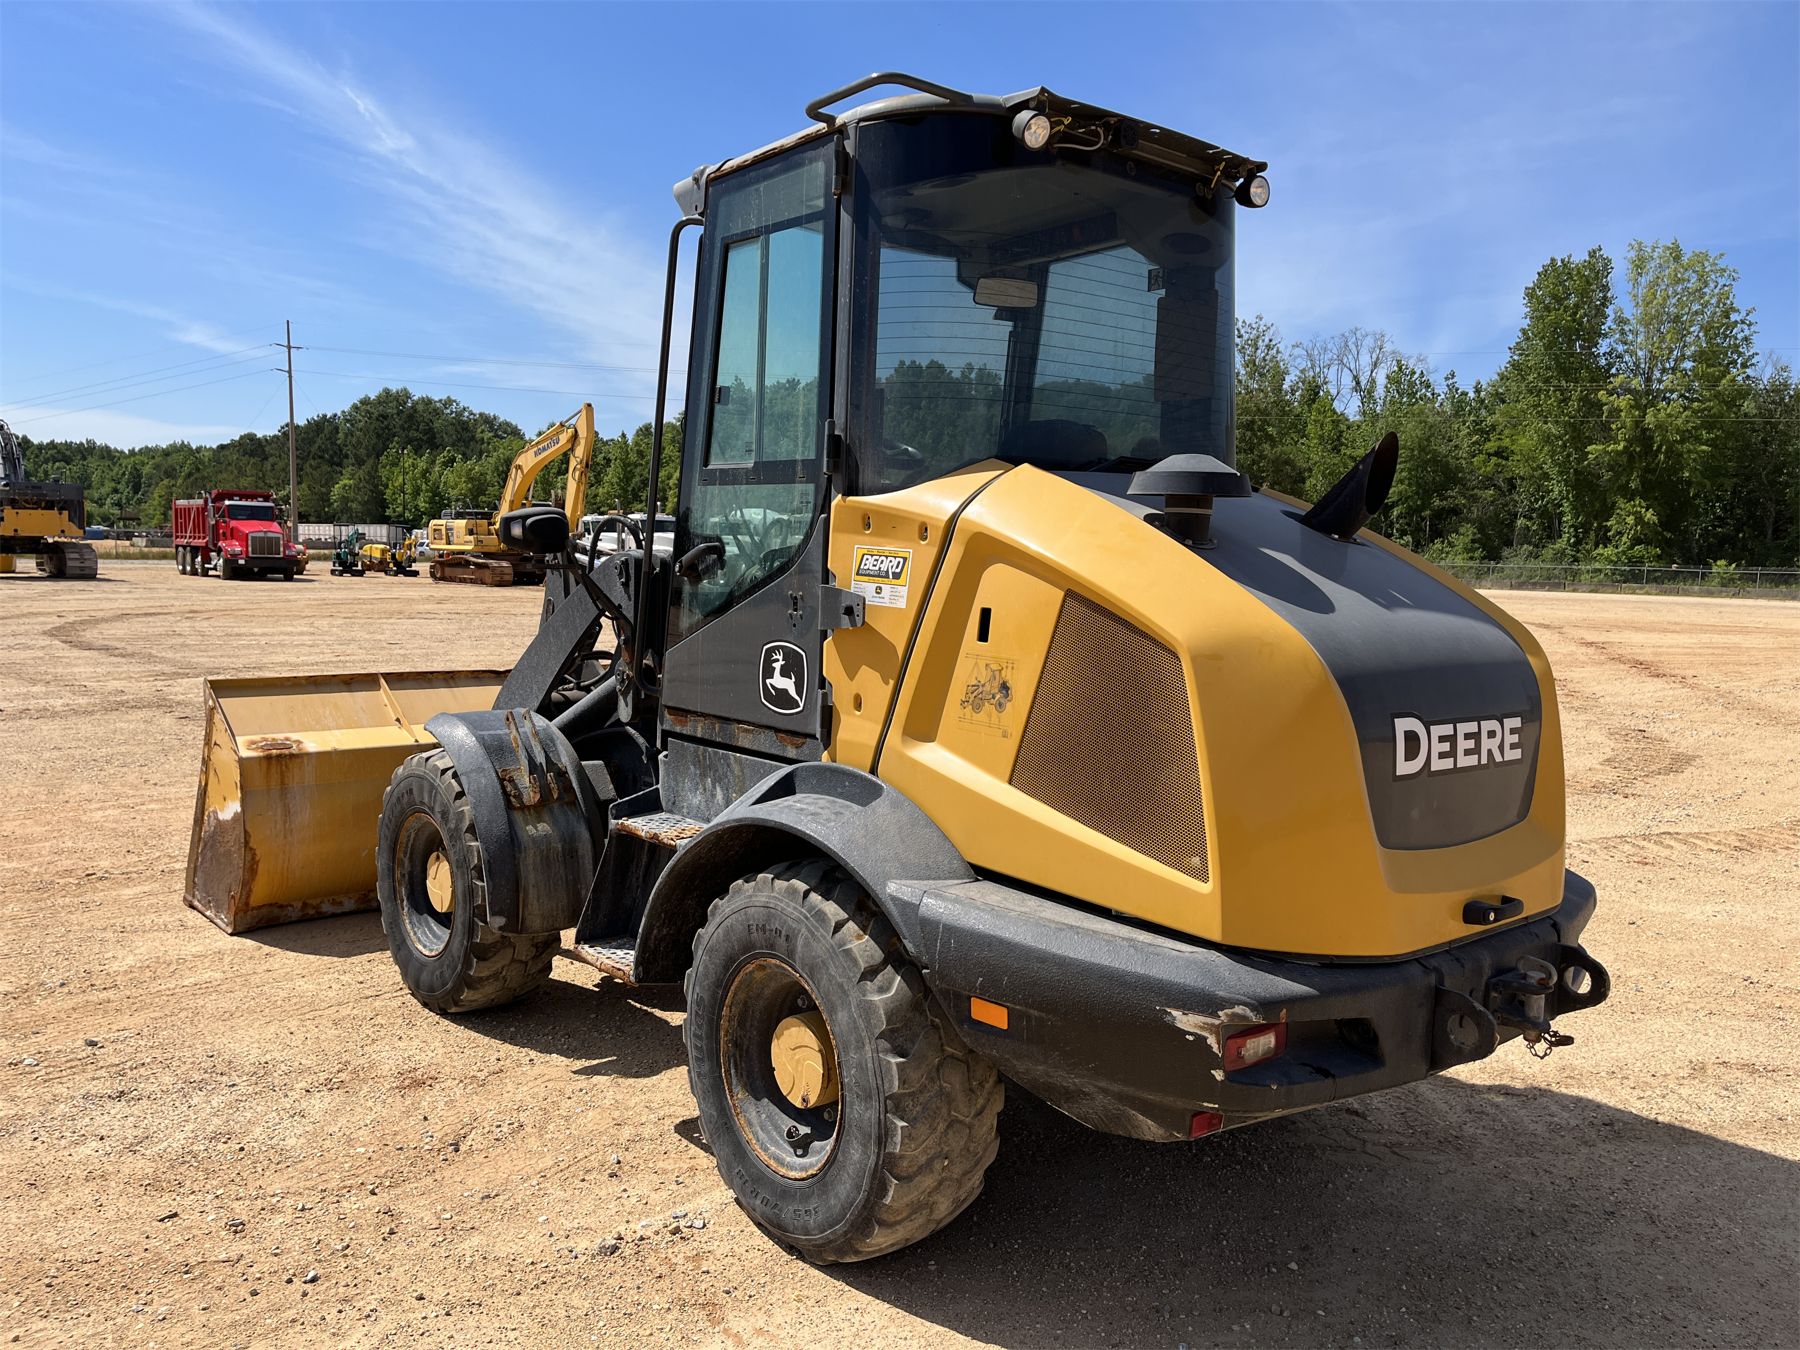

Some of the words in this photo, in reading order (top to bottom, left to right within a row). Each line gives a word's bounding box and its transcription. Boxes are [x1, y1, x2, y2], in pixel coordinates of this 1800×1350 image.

[533, 435, 561, 458] KOMATSU
[860, 554, 904, 579] BEARD
[1394, 716, 1522, 776] DEERE
